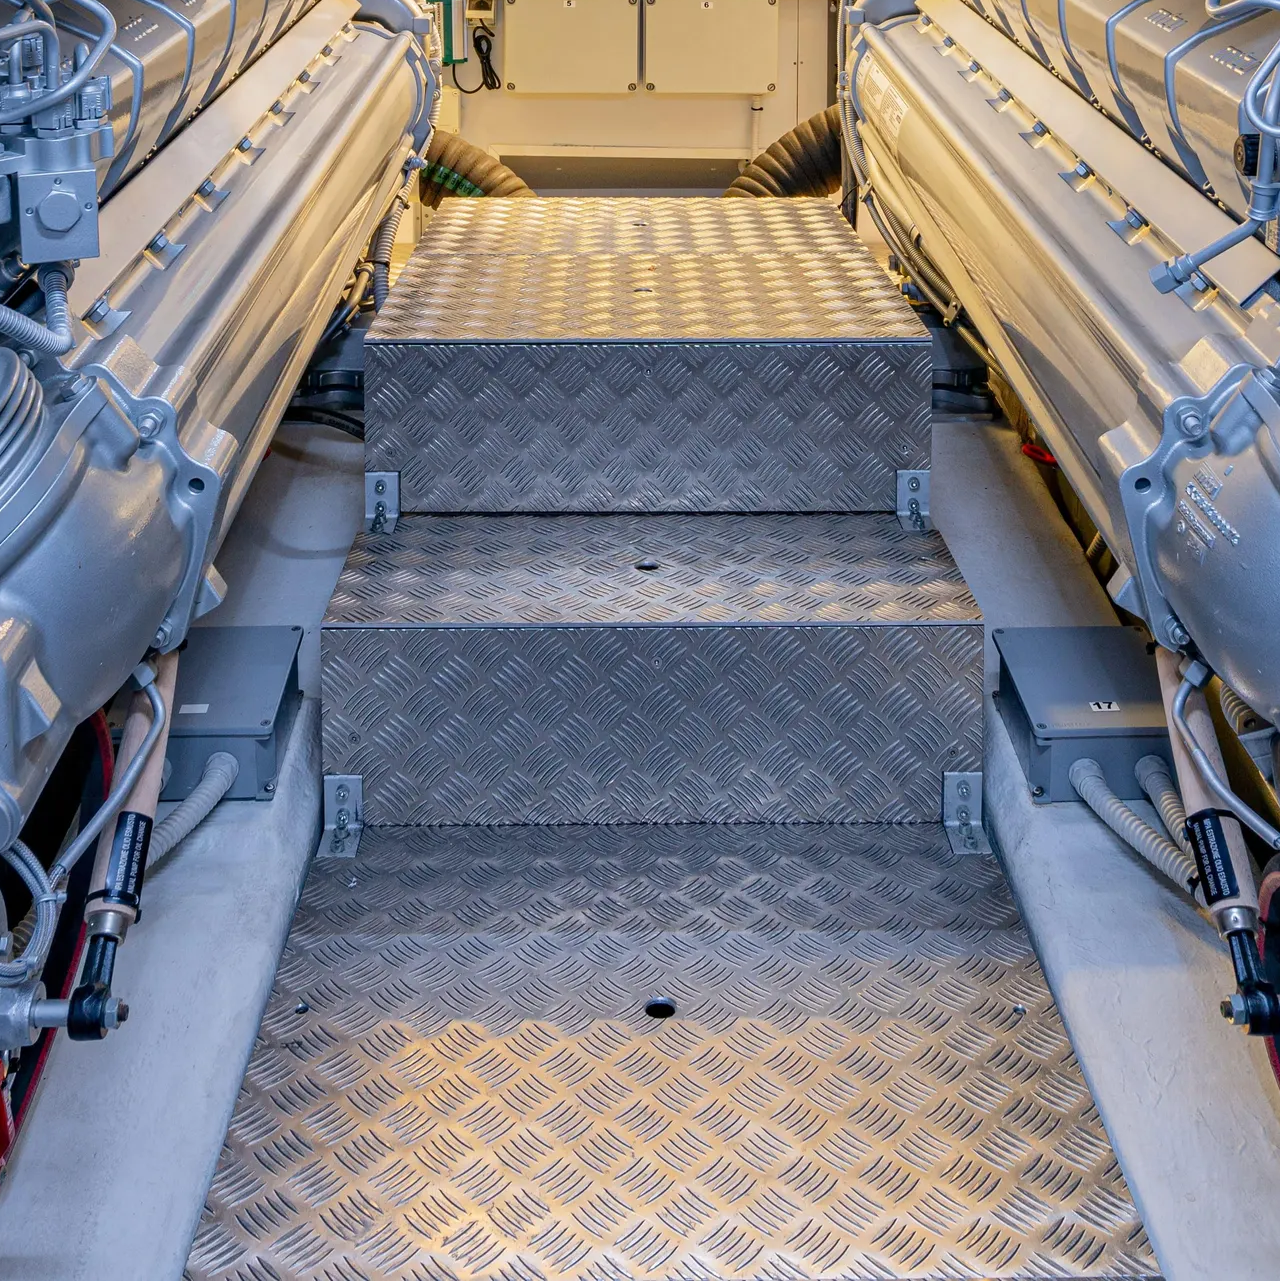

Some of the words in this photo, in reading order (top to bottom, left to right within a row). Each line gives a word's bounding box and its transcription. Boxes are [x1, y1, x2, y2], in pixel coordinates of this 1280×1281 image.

[1093, 701, 1113, 710] 17
[133, 850, 141, 862] FOR
[137, 821, 147, 843] CHANGE
[116, 850, 129, 881] ESTRAZIONE
[1201, 853, 1210, 866] FOR
[1204, 865, 1212, 875] OIL
[1206, 829, 1221, 860] ESTRAZIONE
[1217, 871, 1231, 896] ESAUSTO
[1206, 873, 1218, 896] CHANGE
